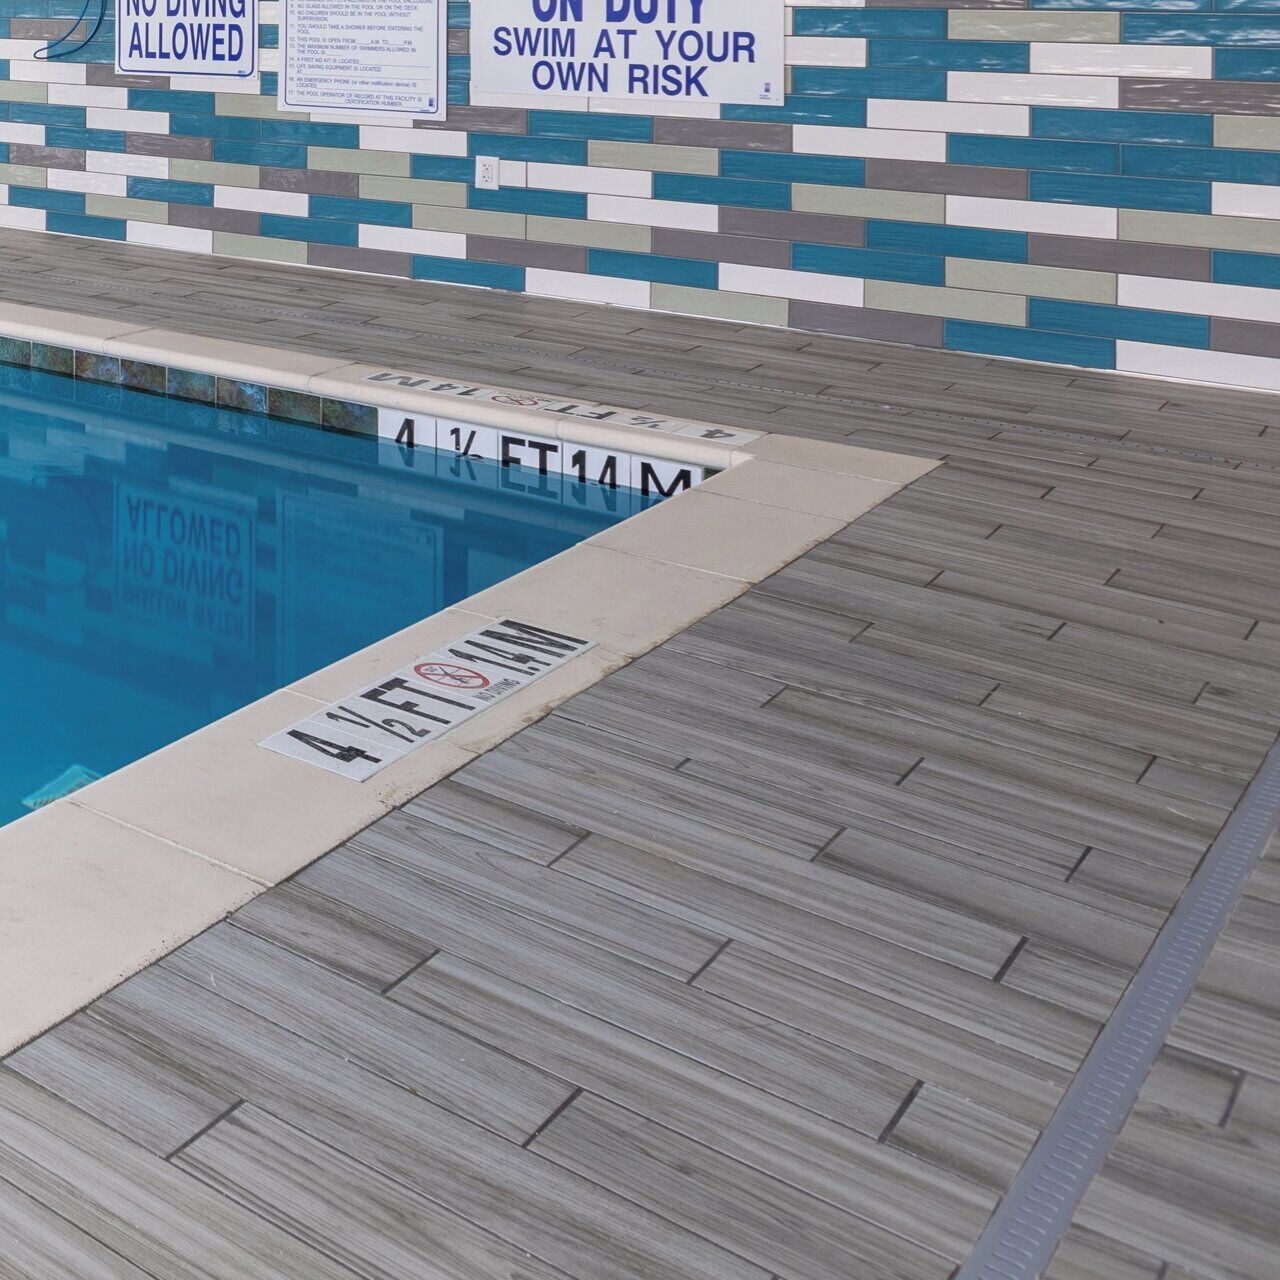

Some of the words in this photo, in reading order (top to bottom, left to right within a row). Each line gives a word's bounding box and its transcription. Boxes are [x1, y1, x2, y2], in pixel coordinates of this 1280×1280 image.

[128, 22, 244, 62] ALLOWED
[493, 27, 577, 58] SWIM
[593, 29, 637, 60] AT
[655, 29, 755, 64] YOUR
[531, 61, 606, 93] OWN
[628, 62, 710, 97] RISK
[543, 404, 619, 420] FT
[500, 434, 559, 476] FT
[640, 461, 692, 497] M
[286, 728, 383, 763] 4
[360, 677, 476, 725] FT
